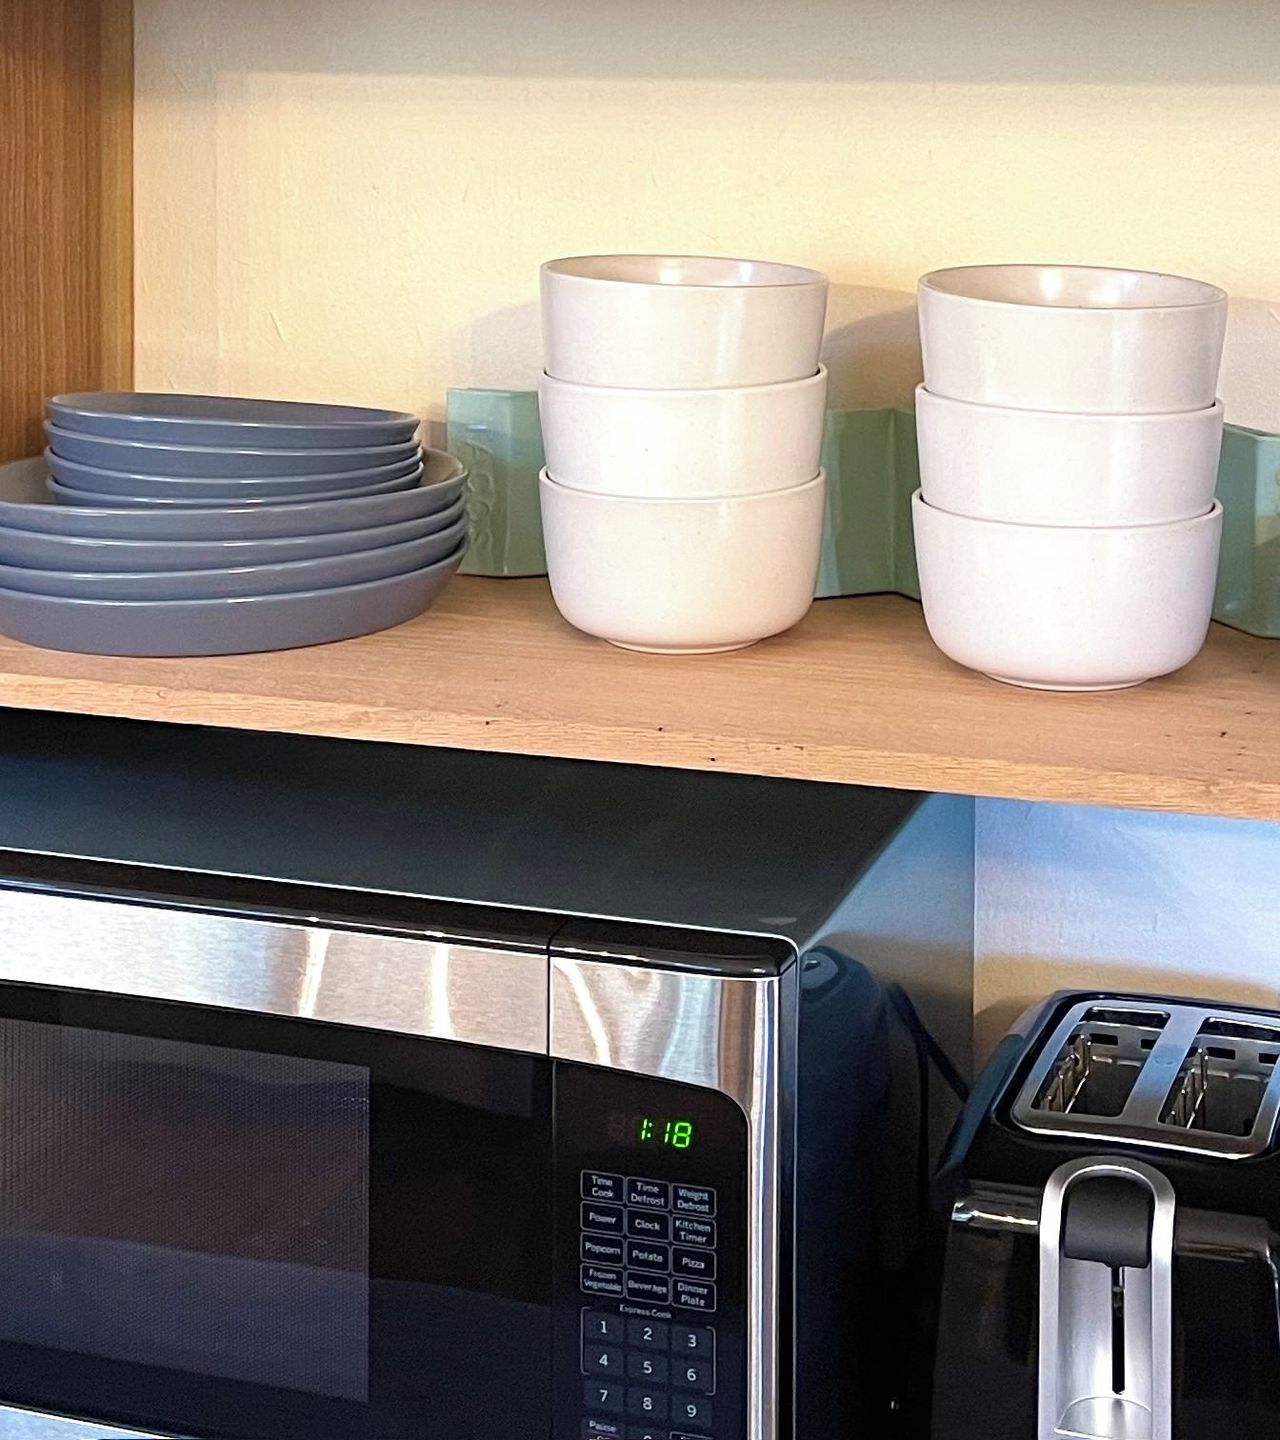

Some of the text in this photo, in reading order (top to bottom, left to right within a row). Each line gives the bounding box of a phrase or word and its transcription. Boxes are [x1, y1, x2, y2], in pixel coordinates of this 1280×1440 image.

[641, 1119, 692, 1148] 1:18
[591, 1175, 613, 1187] Time
[636, 1181, 660, 1194] Time
[591, 1187, 614, 1198] Cook
[630, 1193, 665, 1206] Defrost
[677, 1200, 709, 1212] Defrost
[634, 1219, 660, 1231] Clock
[675, 1220, 711, 1233] Kitchen
[680, 1231, 707, 1243] Timer
[584, 1241, 621, 1255] Popcorn
[632, 1250, 663, 1263] Potato
[682, 1257, 705, 1269] Pizza
[677, 1282, 709, 1295] Dinner
[680, 1294, 705, 1307] Plate
[600, 1321, 607, 1334] 1
[643, 1327, 652, 1341] 2
[688, 1334, 697, 1347] 3
[599, 1354, 608, 1366] 4
[643, 1361, 652, 1374] 5
[686, 1368, 697, 1381] 6
[600, 1389, 608, 1402] 7
[642, 1397, 652, 1410] 8
[686, 1404, 697, 1418] 9
[589, 1420, 616, 1432] Pause
